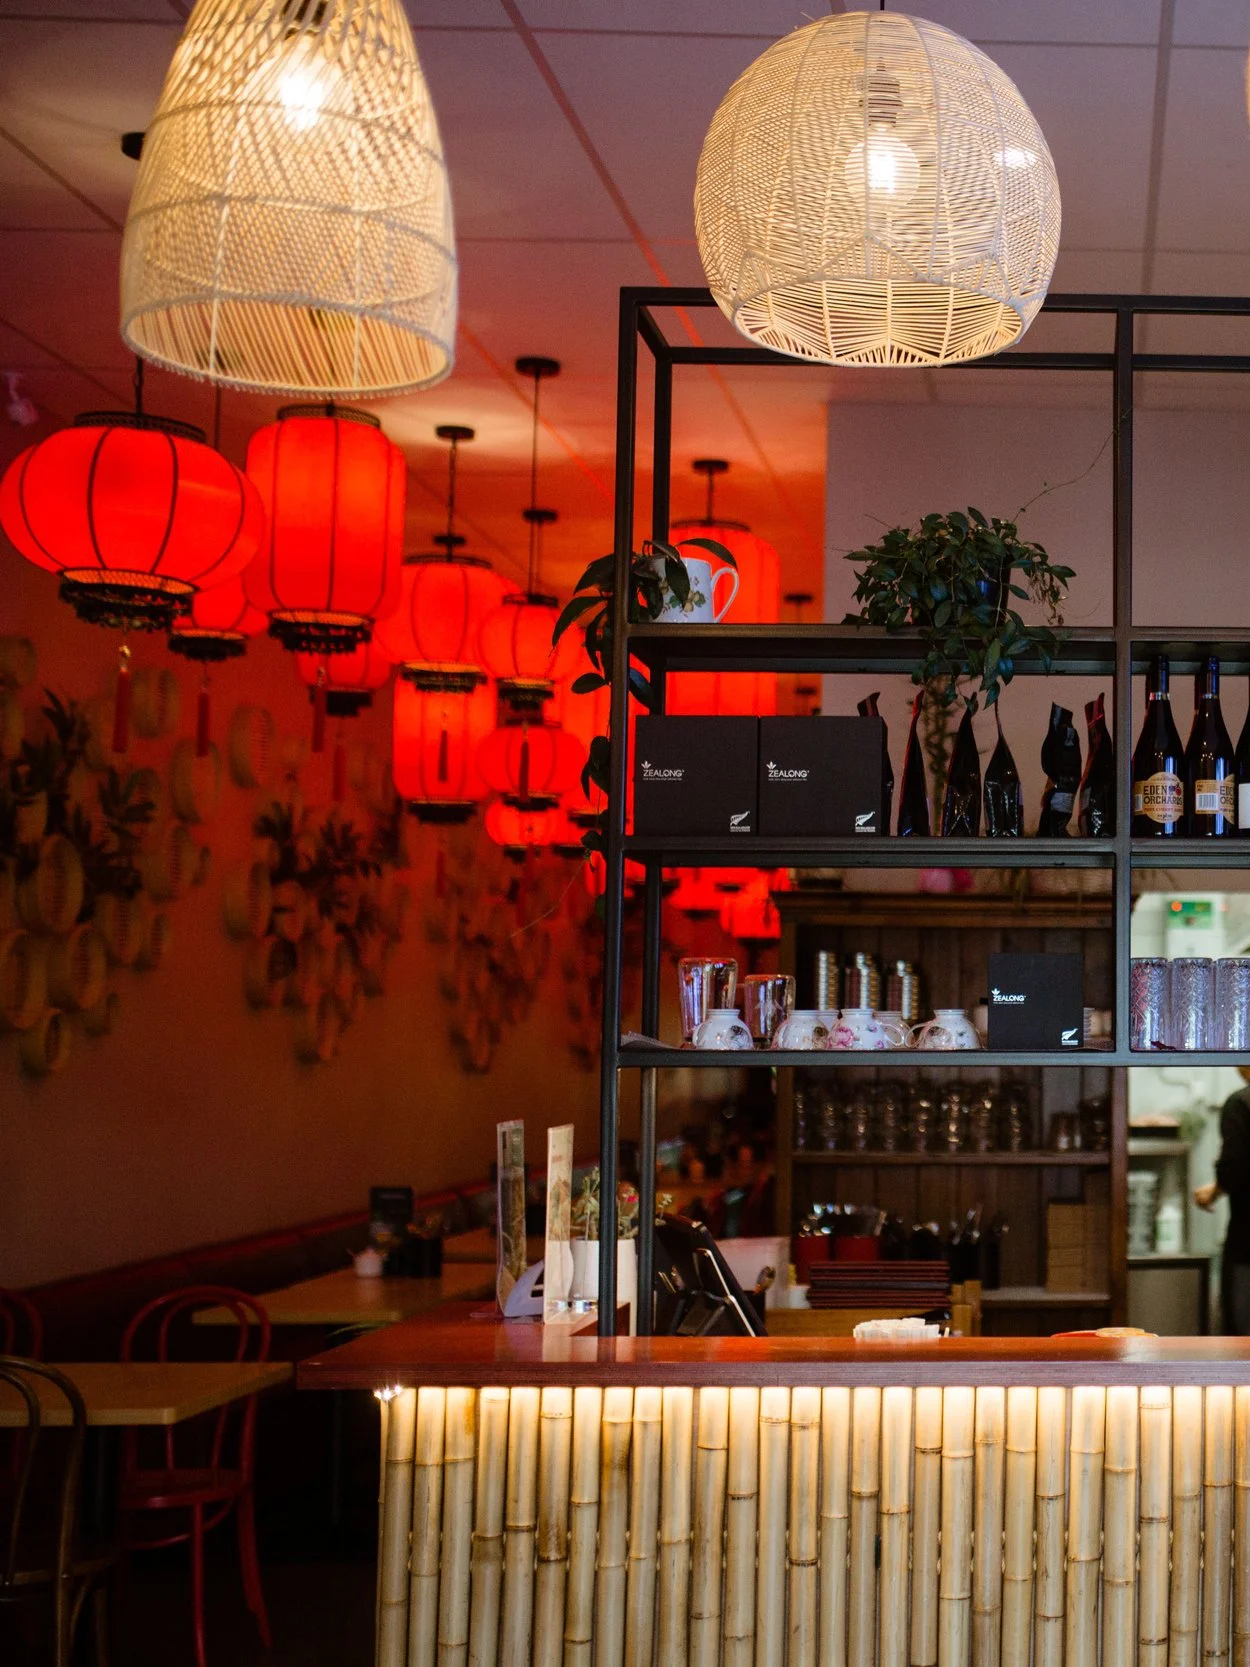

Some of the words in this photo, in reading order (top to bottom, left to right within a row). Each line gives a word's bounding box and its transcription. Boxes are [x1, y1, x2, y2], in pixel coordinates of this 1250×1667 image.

[643, 769, 683, 777] ZEALONG
[768, 769, 808, 778] ZEALONG
[1143, 785, 1167, 796] EDEN
[1143, 795, 1183, 806] ORCHARDS
[993, 994, 1025, 1002] ZEALONG
